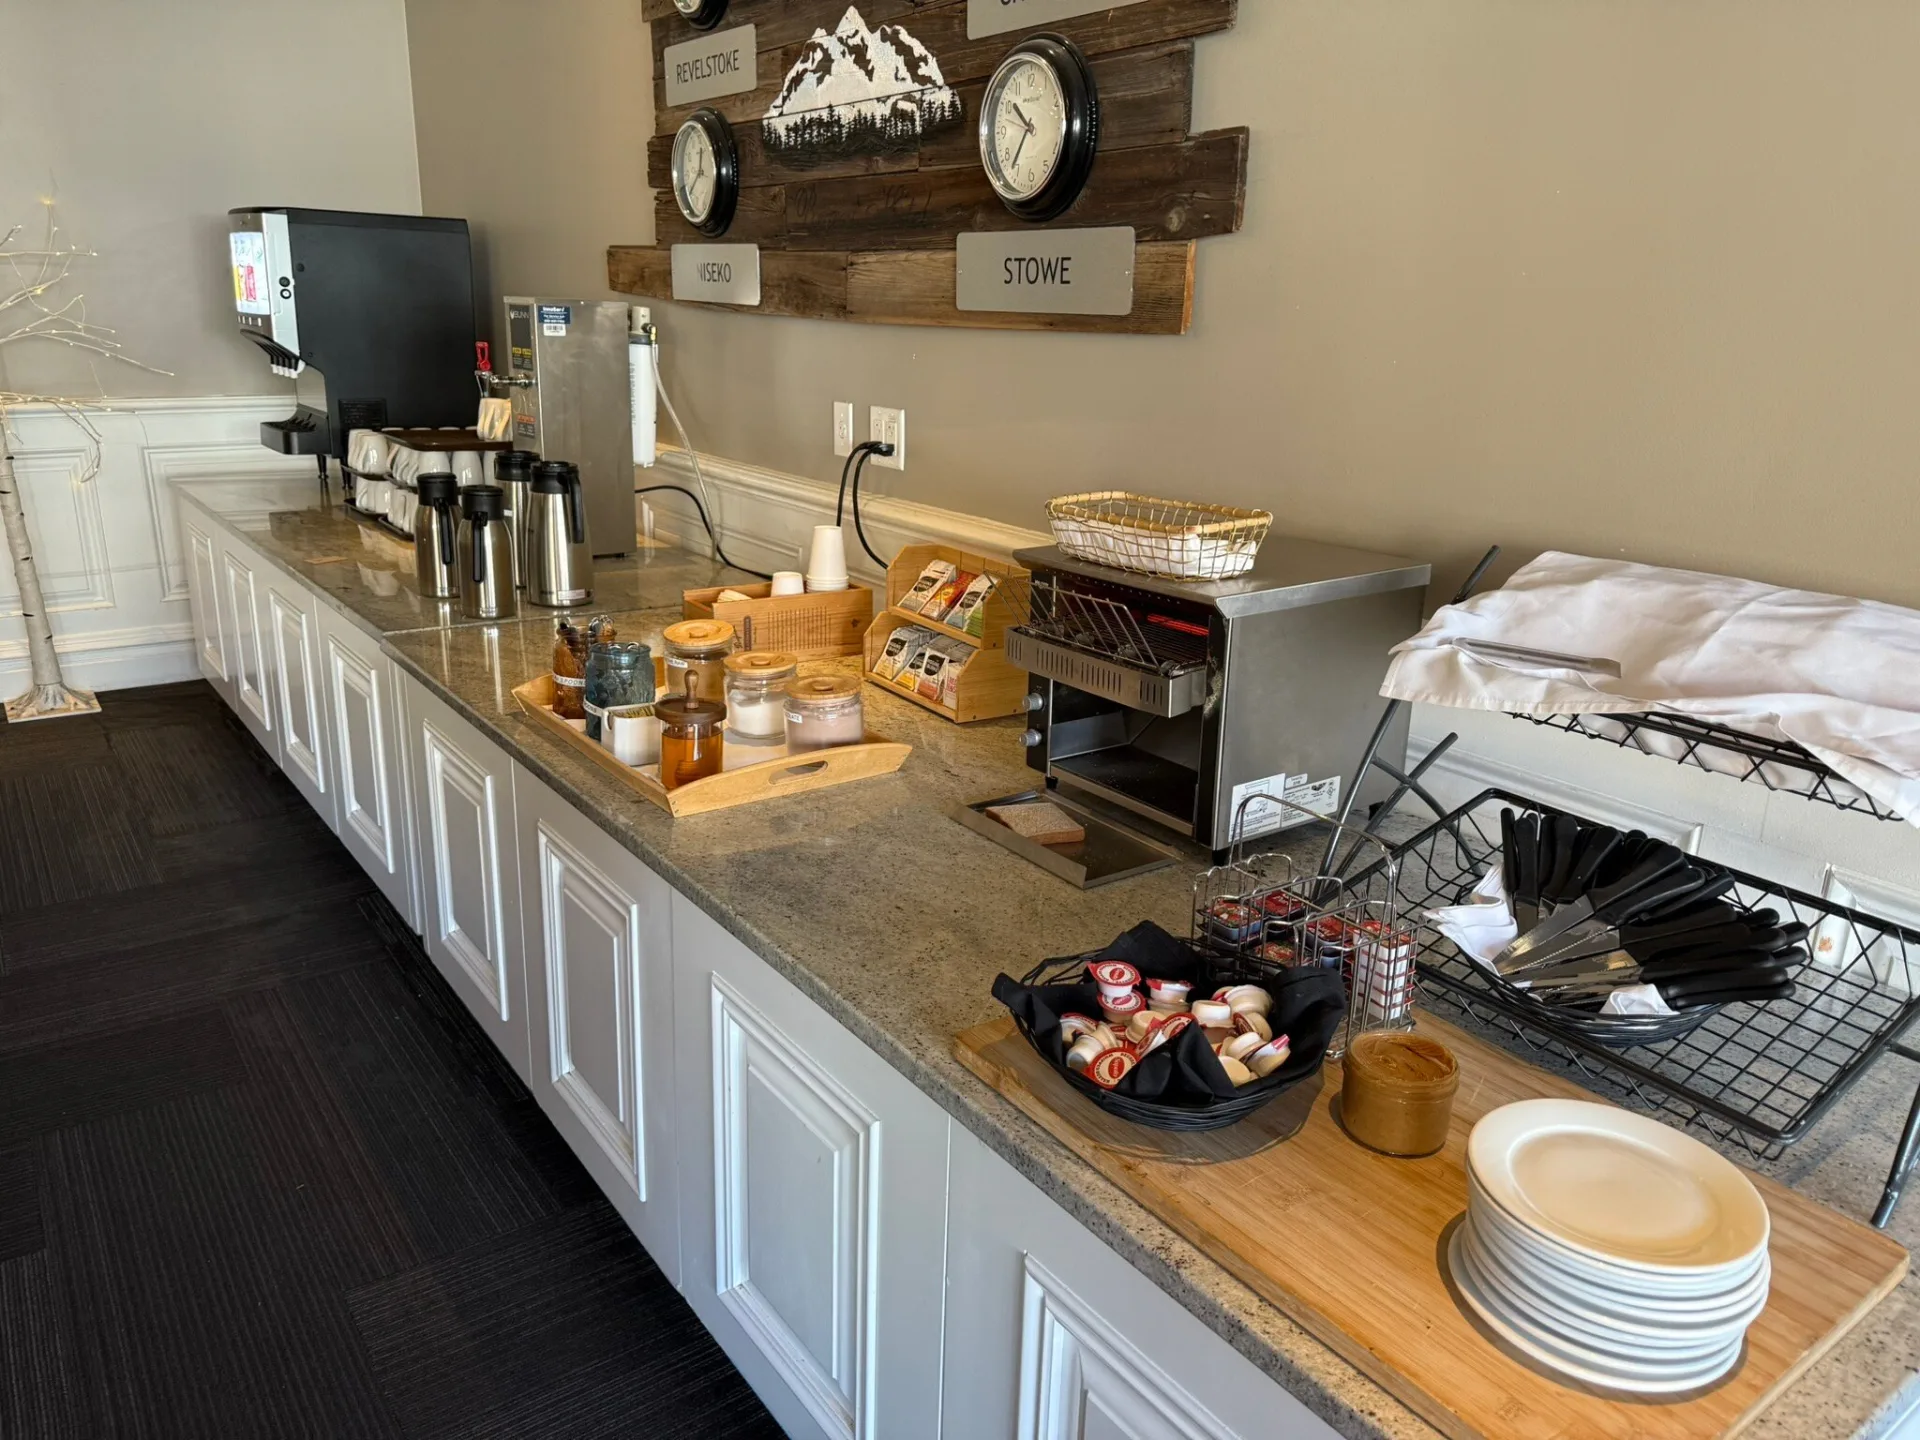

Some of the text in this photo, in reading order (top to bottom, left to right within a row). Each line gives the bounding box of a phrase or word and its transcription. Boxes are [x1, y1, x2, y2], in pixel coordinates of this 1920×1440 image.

[676, 49, 740, 85] REVELSTOKE
[1027, 73, 1035, 88] 12
[1015, 81, 1021, 96] 11
[1005, 100, 1012, 114] 10
[1001, 126, 1007, 139] 9
[1004, 147, 1010, 161] 8
[1043, 159, 1049, 174] 5
[1028, 168, 1035, 182] 6
[1003, 256, 1072, 285] STOWE
